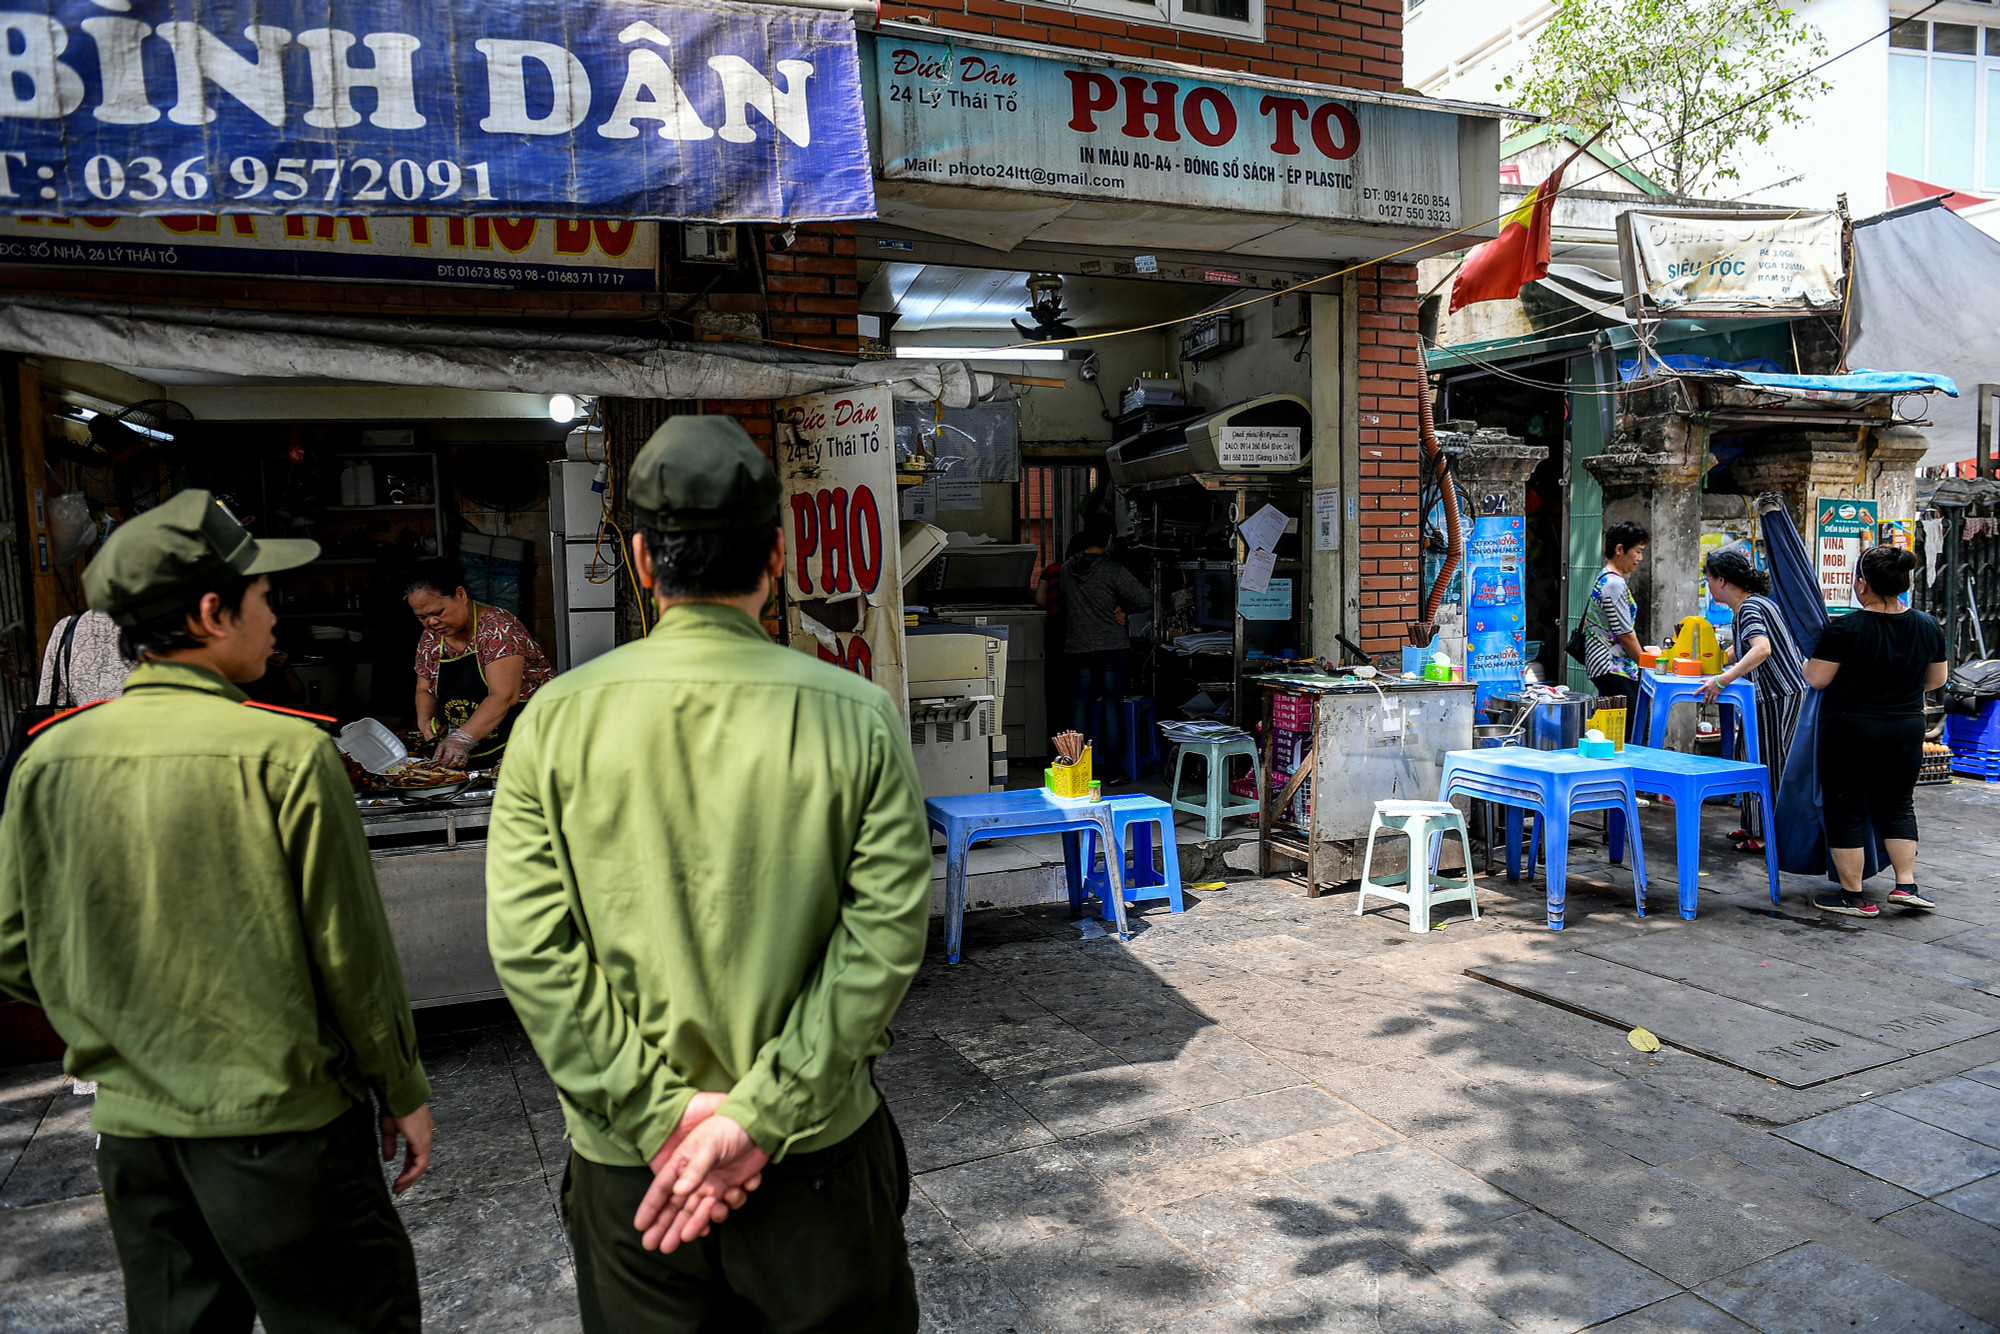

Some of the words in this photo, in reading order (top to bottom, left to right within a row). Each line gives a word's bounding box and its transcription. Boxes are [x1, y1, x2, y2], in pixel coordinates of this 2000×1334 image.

[475, 20, 814, 148] DÂN
[959, 56, 1017, 87] Dân
[889, 84, 912, 103] 24
[947, 89, 988, 110] Thái
[993, 90, 1017, 113] Tổ
[1064, 69, 1237, 147] PHO
[1259, 94, 1361, 160] TO
[83, 154, 209, 201] 036
[229, 155, 498, 202] 9572091
[903, 157, 943, 173] Mail:
[948, 161, 1125, 189] photo24ltt@gmail.com
[1080, 146, 1094, 164] IN
[1099, 146, 1129, 168] MÀU
[1184, 154, 1219, 177] ĐÓNG
[1223, 155, 1239, 179] SỔ
[1243, 162, 1275, 183] SÁCH
[1287, 165, 1302, 185] ÉP
[1305, 170, 1353, 190] PLASTIC
[1363, 187, 1381, 200] ĐT:
[1384, 189, 1409, 203] 0914
[1411, 192, 1429, 206] 260
[1432, 195, 1450, 208] 854
[1378, 204, 1403, 217] 0127
[1406, 207, 1424, 220] 550
[1427, 209, 1451, 223] 3323
[29, 241, 50, 258] SỐ
[53, 244, 86, 260] NHÀ
[89, 247, 105, 261] 26
[108, 245, 124, 261] LÝ
[126, 247, 156, 263] THÁI
[158, 246, 178, 264] TỔ
[1667, 258, 1702, 279] SIÊU
[1708, 253, 1746, 276] TỐC
[1758, 262, 1777, 270] VGA
[437, 265, 455, 277] ĐT:
[457, 265, 491, 279] 01673
[493, 267, 507, 280] 85
[509, 269, 523, 281] 93
[525, 269, 539, 282] 98
[547, 270, 580, 284] 01683
[582, 272, 593, 284] 71
[599, 273, 609, 285] 17
[613, 274, 624, 286] 17
[834, 399, 878, 427] Dân
[826, 434, 857, 458] Thái
[860, 423, 880, 455] Tổ
[1484, 493, 1508, 514] 24
[790, 484, 883, 595] PHO
[1823, 537, 1844, 550] VINA
[1823, 554, 1846, 567] MOBI
